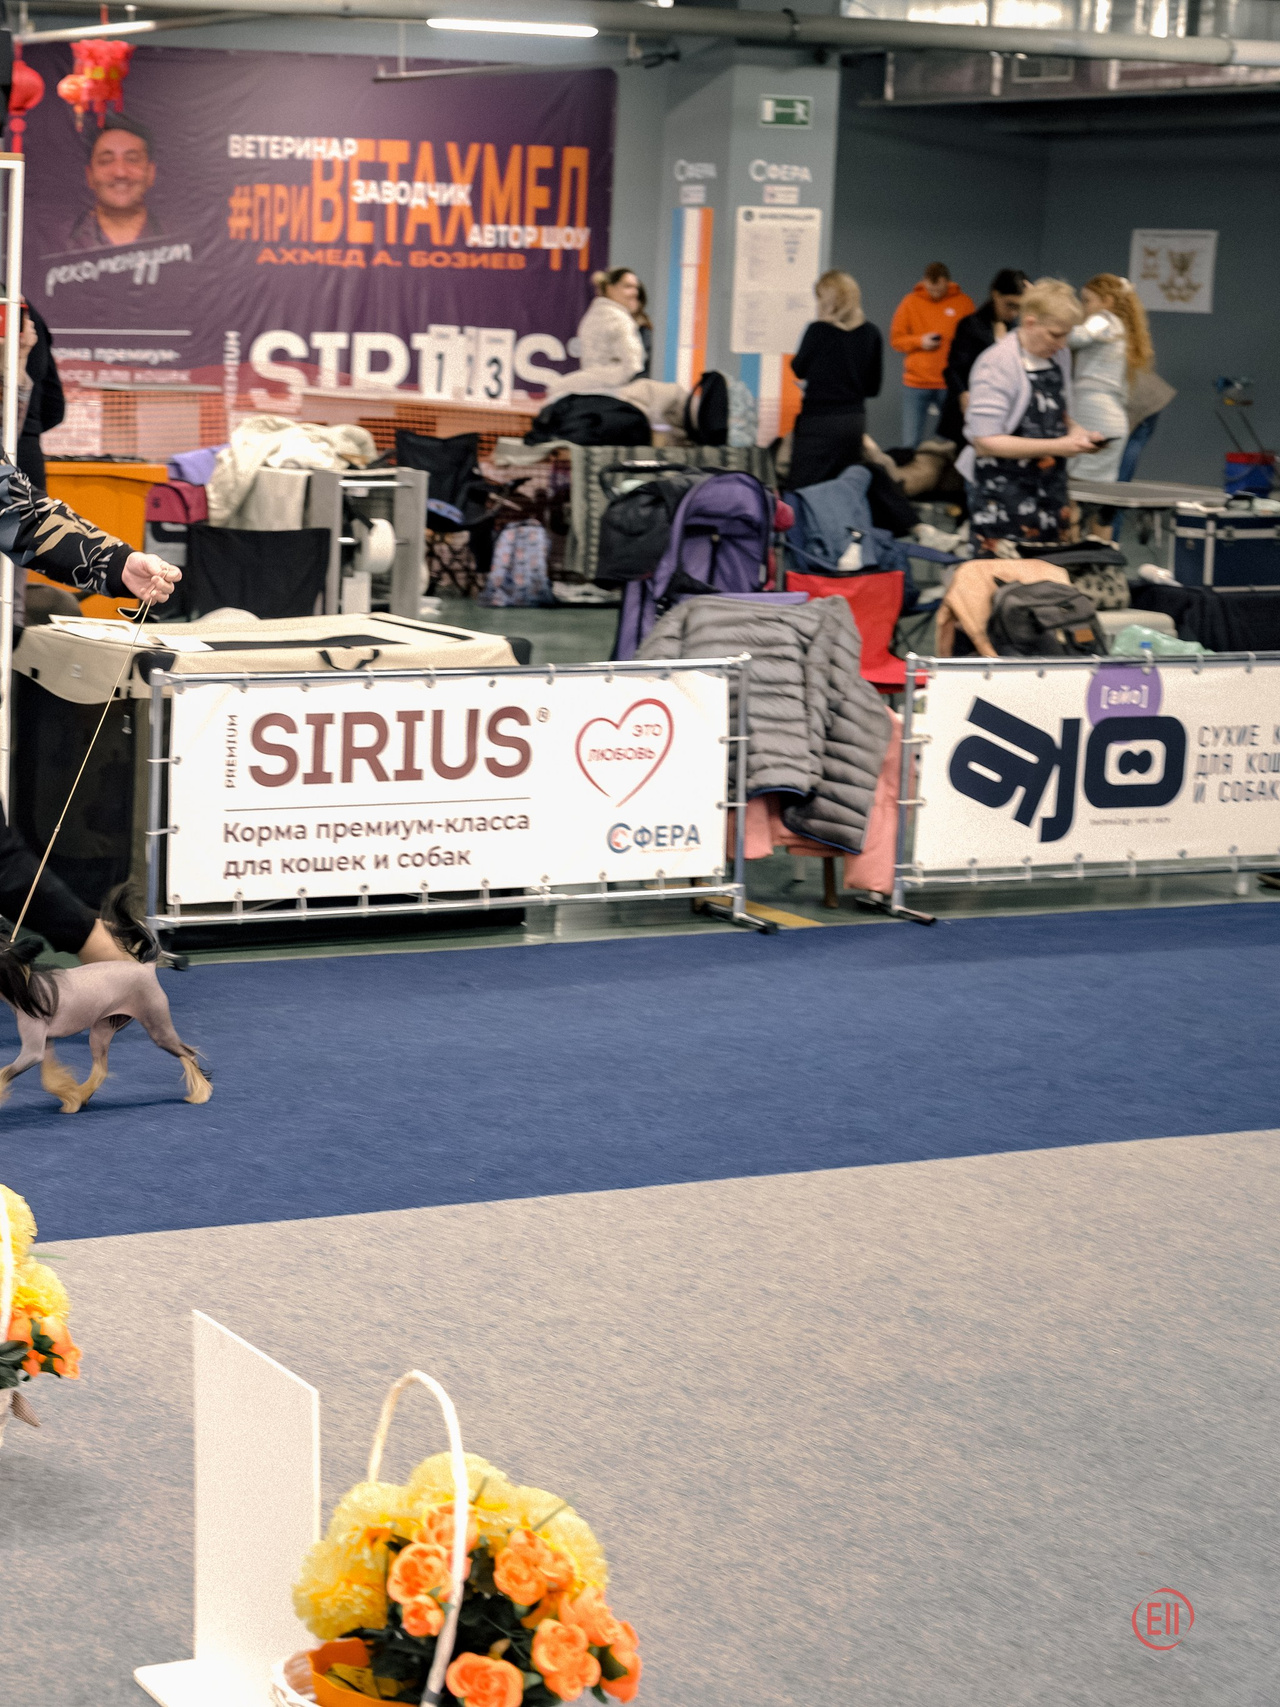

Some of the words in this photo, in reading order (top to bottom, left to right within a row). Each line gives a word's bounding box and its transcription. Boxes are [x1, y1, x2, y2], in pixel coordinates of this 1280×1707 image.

[228, 134, 358, 161] ВЕТЕРИНАР
[351, 179, 472, 210] ЗАВОДЧИК
[466, 224, 535, 248] АВТОР
[541, 225, 591, 249] ШОУ
[256, 247, 366, 269] АХМЕД
[372, 249, 402, 268] А.
[409, 250, 527, 270] БОЗИЕВ
[484, 357, 503, 399] 3
[632, 723, 664, 738] ЭТО
[1198, 724, 1261, 748] СУХИЕ
[224, 714, 239, 789] PREMIUM
[587, 747, 657, 762] ЛЮБОВЬ
[1194, 753, 1233, 780] ДЛЯ
[1245, 752, 1280, 774] КОШ
[1193, 782, 1206, 804] И
[223, 820, 308, 847] Корма
[315, 813, 531, 844] премиум-класса
[607, 822, 701, 854] СФЕРА
[223, 858, 272, 880] для
[280, 853, 366, 874] кошек
[373, 851, 389, 870] и
[397, 846, 472, 869] собак
